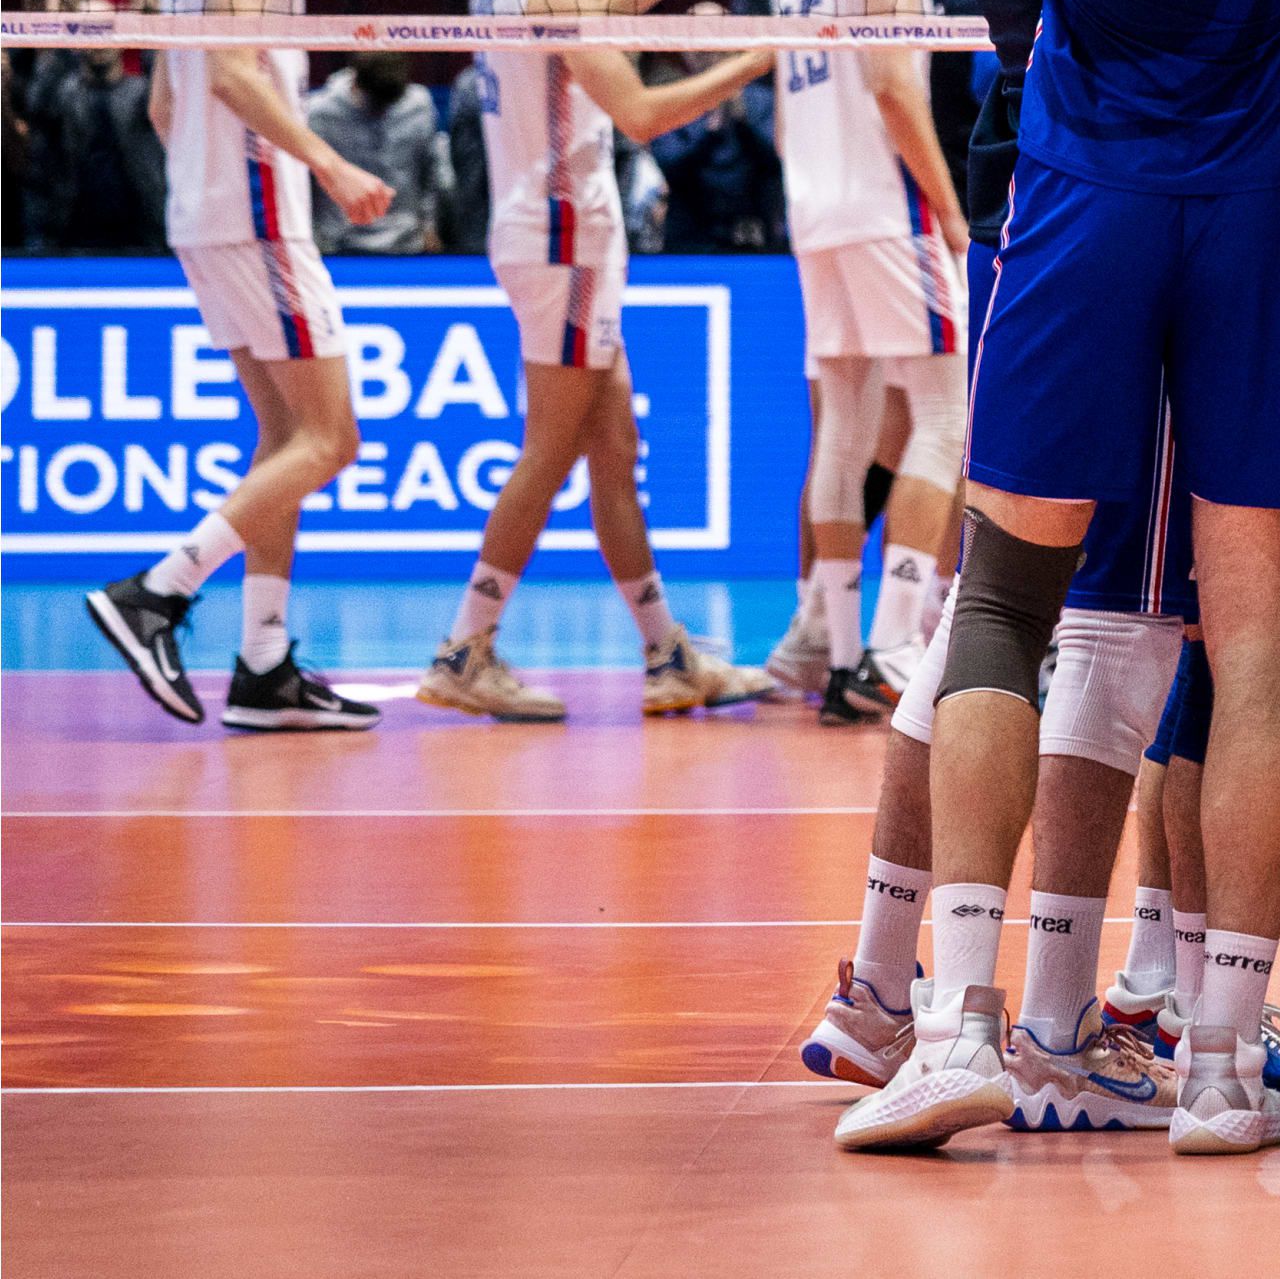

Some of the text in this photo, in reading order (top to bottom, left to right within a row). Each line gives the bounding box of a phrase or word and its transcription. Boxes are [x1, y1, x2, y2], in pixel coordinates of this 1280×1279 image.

[387, 26, 494, 40] VOLLEYBALL
[849, 26, 953, 39] VOLLEYBALL
[0, 443, 244, 514] IONS
[868, 876, 918, 903] rrea
[1215, 951, 1273, 976] errea
